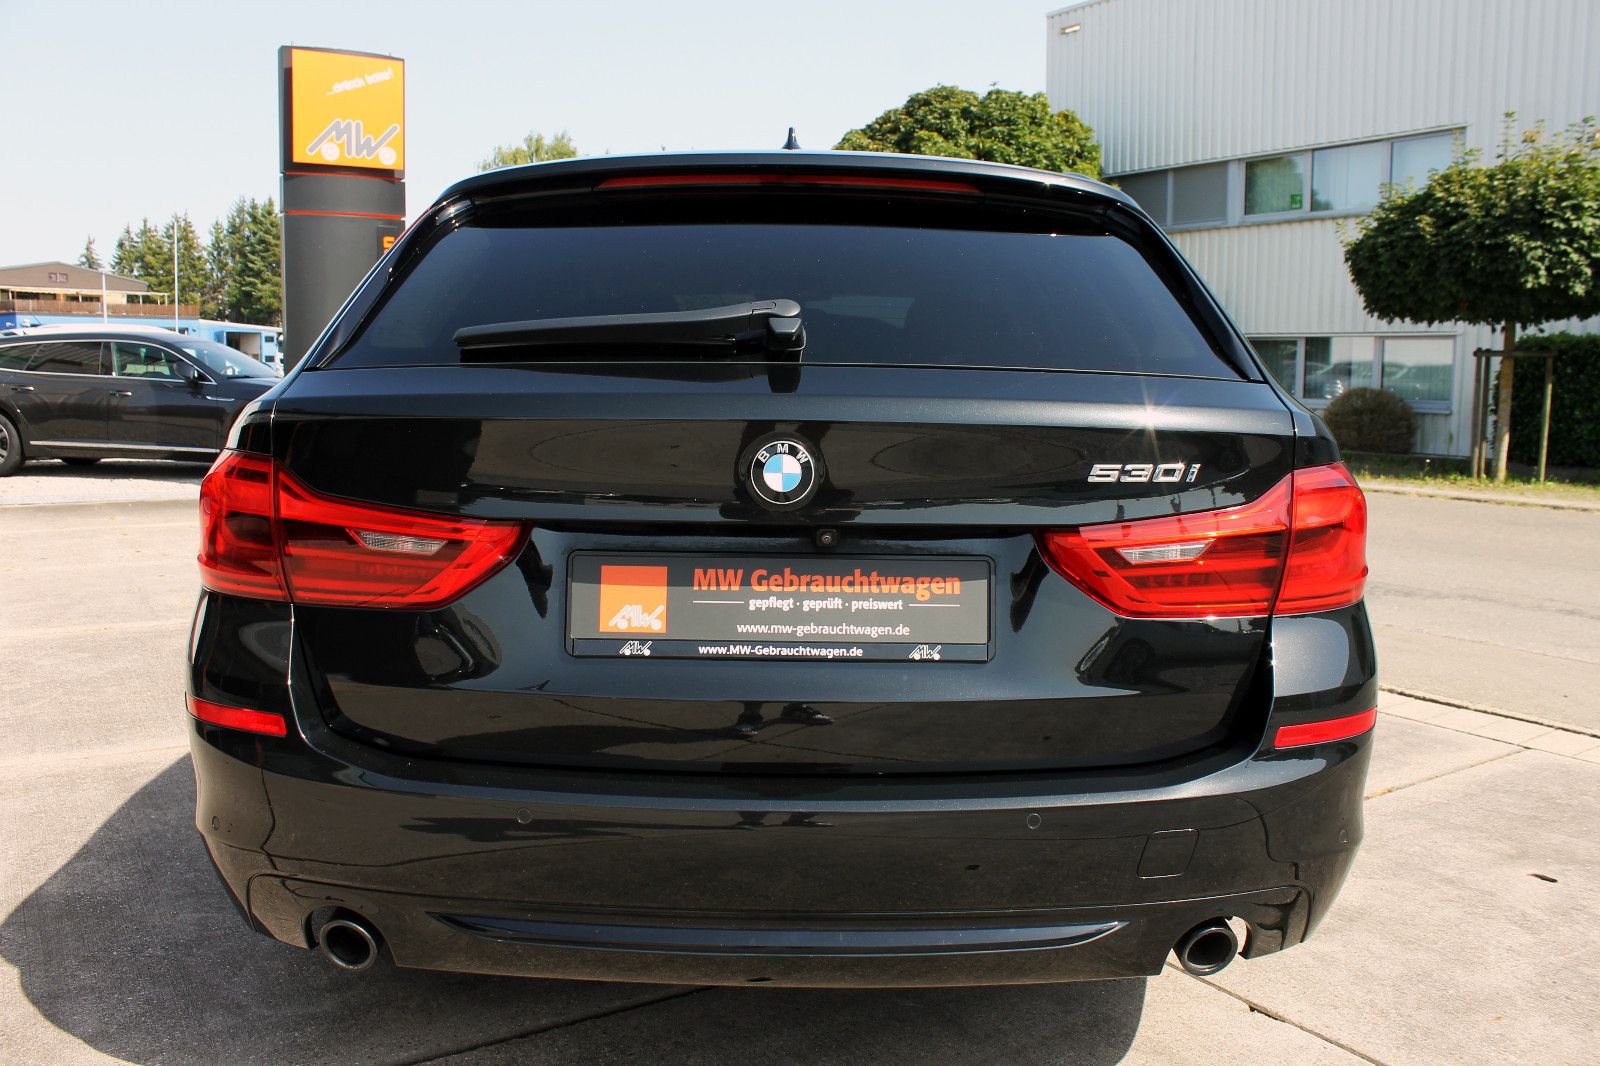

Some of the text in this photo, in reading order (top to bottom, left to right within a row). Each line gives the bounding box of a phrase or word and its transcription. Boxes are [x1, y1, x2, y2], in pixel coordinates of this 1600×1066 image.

[758, 443, 809, 464] BMW
[1087, 463, 1201, 483] 530i
[693, 567, 961, 602] MW Gebrauchtwagen
[748, 596, 904, 613] gepflegt geprüft preiswert
[736, 622, 910, 639] www.mw-gebrauchtwagen.de
[698, 643, 864, 659] www.MW-Gebrauchtwagen.de
